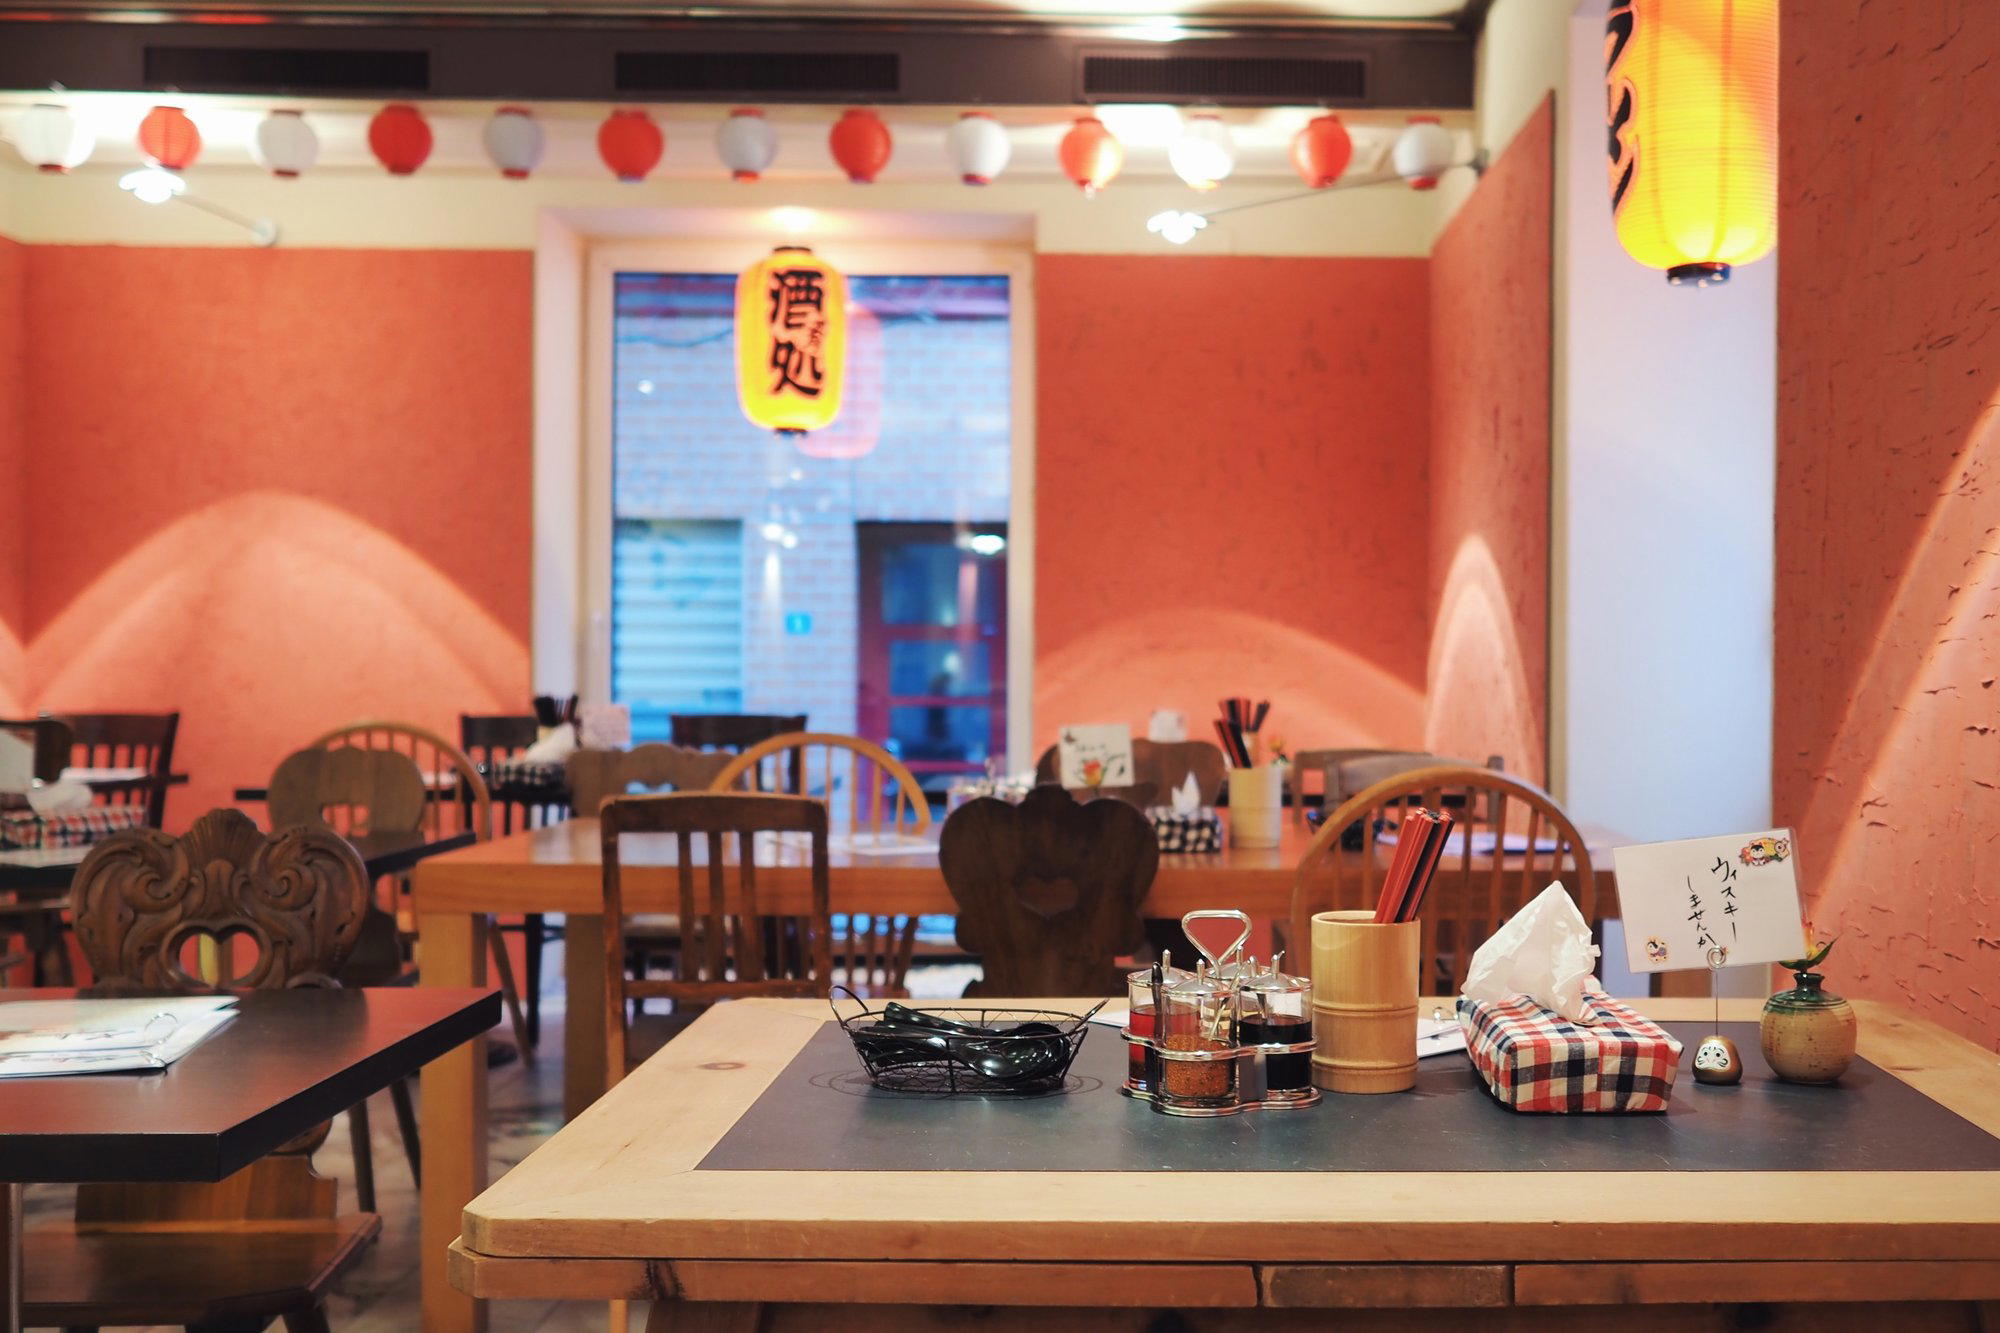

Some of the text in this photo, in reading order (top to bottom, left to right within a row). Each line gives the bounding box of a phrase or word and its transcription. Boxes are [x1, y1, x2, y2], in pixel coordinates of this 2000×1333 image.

[770, 270, 823, 395] 酒処
[1687, 875, 1717, 948] しませんか
[1711, 857, 1738, 942] ウィスキー
